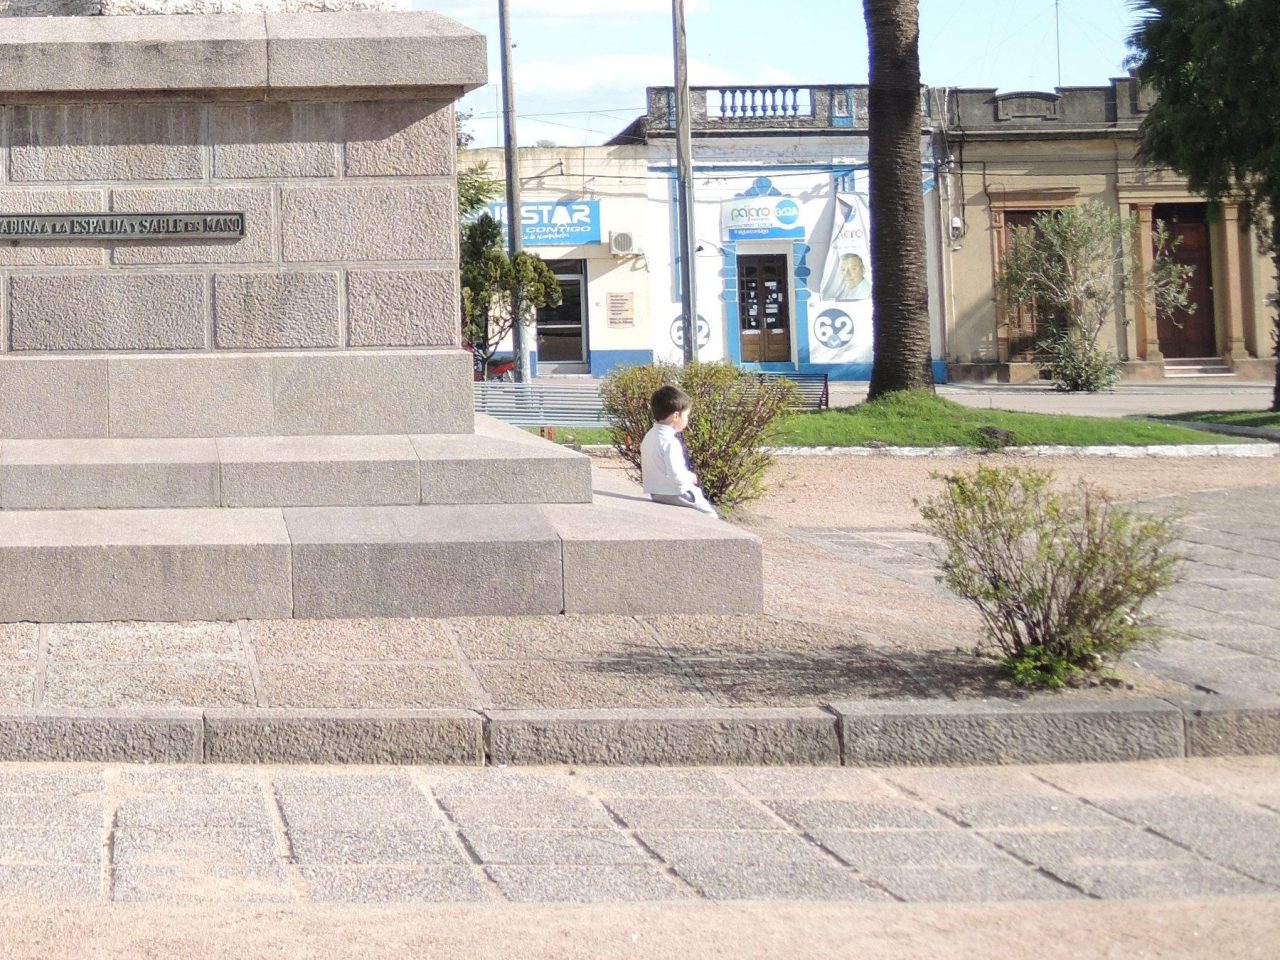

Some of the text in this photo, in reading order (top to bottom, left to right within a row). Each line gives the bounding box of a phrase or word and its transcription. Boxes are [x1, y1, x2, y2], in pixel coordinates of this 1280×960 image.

[54, 221, 69, 233] LA
[72, 218, 130, 233] ESPALDA
[140, 218, 183, 232] SABLE
[205, 217, 242, 231] MANO
[525, 226, 591, 234] CONTIGO
[815, 316, 853, 342] 62
